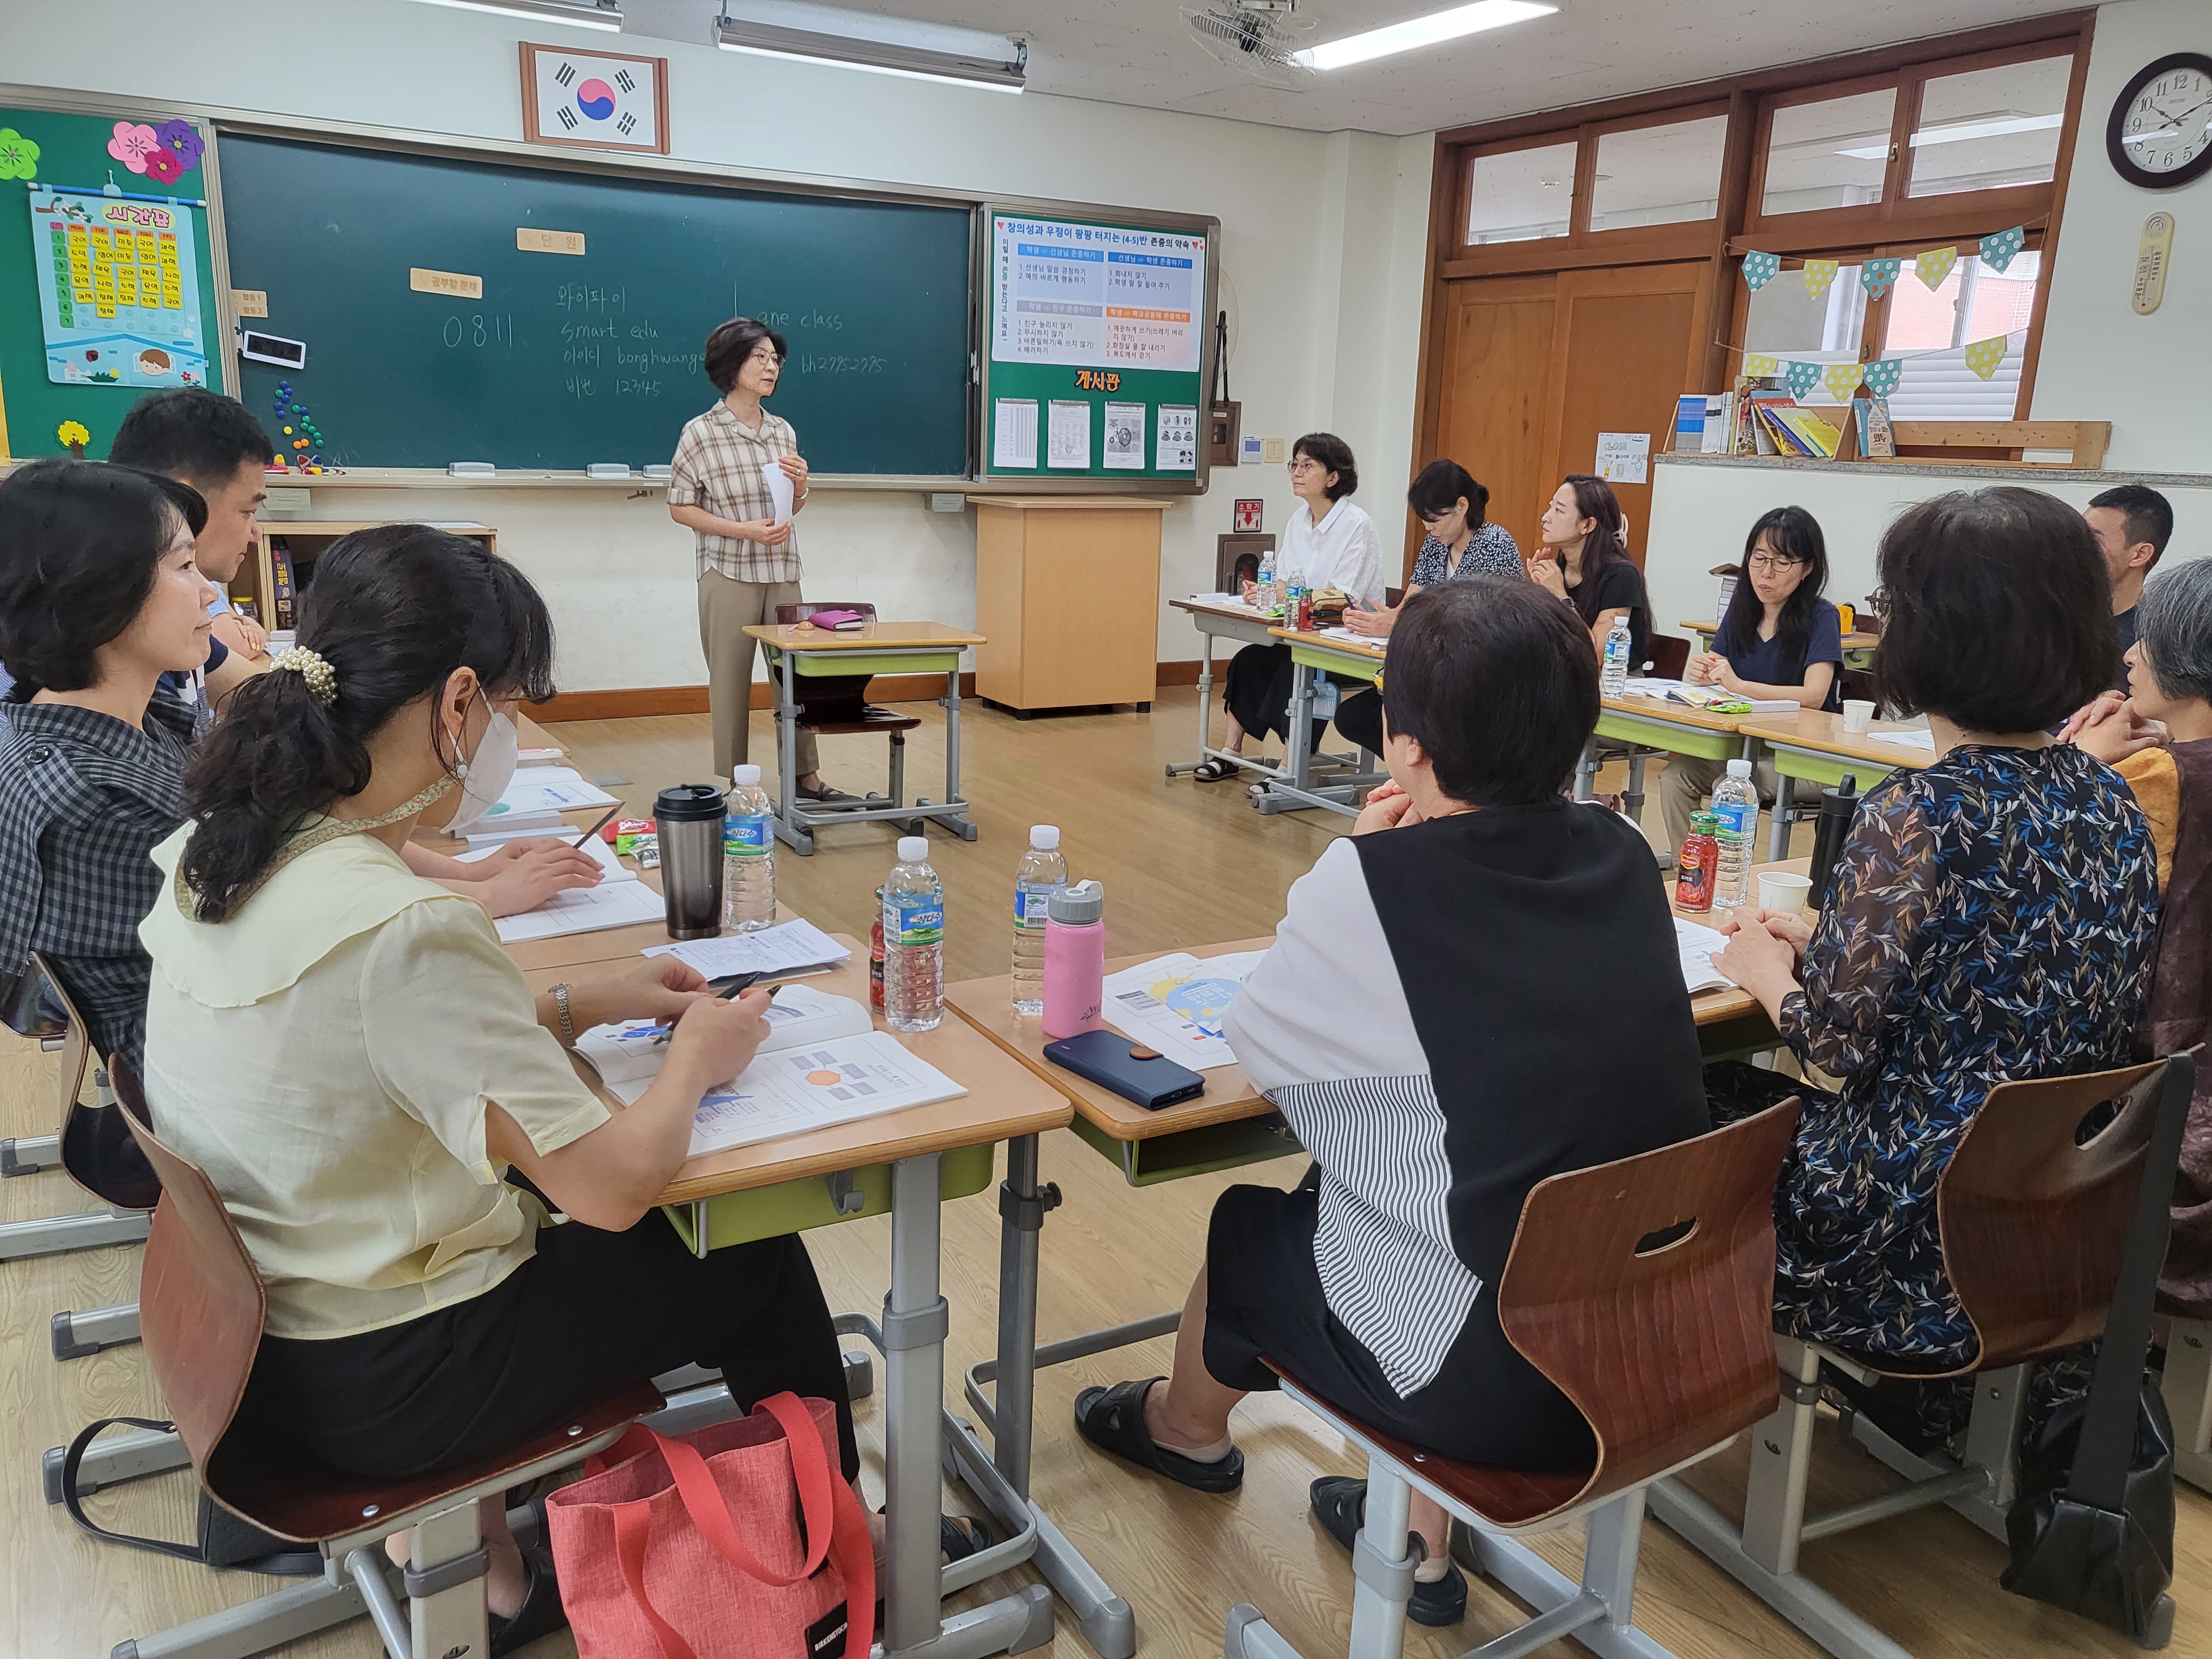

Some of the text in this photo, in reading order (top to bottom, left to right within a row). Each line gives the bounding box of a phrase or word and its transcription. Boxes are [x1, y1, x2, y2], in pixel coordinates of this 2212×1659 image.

[2155, 81, 2167, 97] 11
[2173, 74, 2187, 90] 12
[2194, 77, 2200, 92] 1
[2139, 96, 2153, 112] 10
[2132, 118, 2141, 132] 9
[2198, 131, 2209, 144] 4
[2147, 150, 2156, 164] 7
[2164, 152, 2173, 166] 6
[2183, 146, 2192, 160] 5
[106, 205, 170, 228] 시간표
[95, 236, 108, 246] 국어
[139, 238, 153, 247] 국어
[1008, 222, 1190, 250] 창의성과 우정이 팡팡 터지는 (4-5)반 존중의 약속
[1026, 245, 1095, 259] 학생 선생님 존중하기
[1118, 254, 1136, 263] 선생님
[1160, 259, 1183, 267] 존중하기
[121, 268, 134, 276] 국어
[1026, 264, 1044, 273] 선생님
[1047, 264, 1058, 274] 말씀
[1062, 267, 1086, 276] 경청하기
[1115, 270, 1133, 279] 화내지
[1135, 272, 1146, 280] 않기
[1026, 273, 1038, 281] 예의
[1040, 274, 1058, 282] 바르게
[1062, 275, 1086, 285] 행동하기
[1115, 279, 1126, 287] 학생
[1159, 282, 1170, 290] 주기
[461, 280, 477, 293] 문제
[555, 284, 625, 314] 와이파이
[801, 309, 843, 331] class
[1024, 320, 1036, 328] 친구
[1040, 320, 1057, 329] 놀리지
[1060, 322, 1072, 330] 않기
[444, 314, 513, 348] 0811
[630, 319, 659, 340] edu
[1024, 329, 1048, 337] 무시하지
[1113, 325, 1136, 333] 깨끗하게
[1065, 340, 1077, 348] 쓰지
[1080, 340, 1094, 349] 않기)
[1113, 342, 1130, 351] 화장실
[1148, 344, 1166, 352] 내리기
[1113, 351, 1136, 359] 복도에서
[615, 379, 662, 397] 12345
[1075, 370, 1121, 392] 게시판
